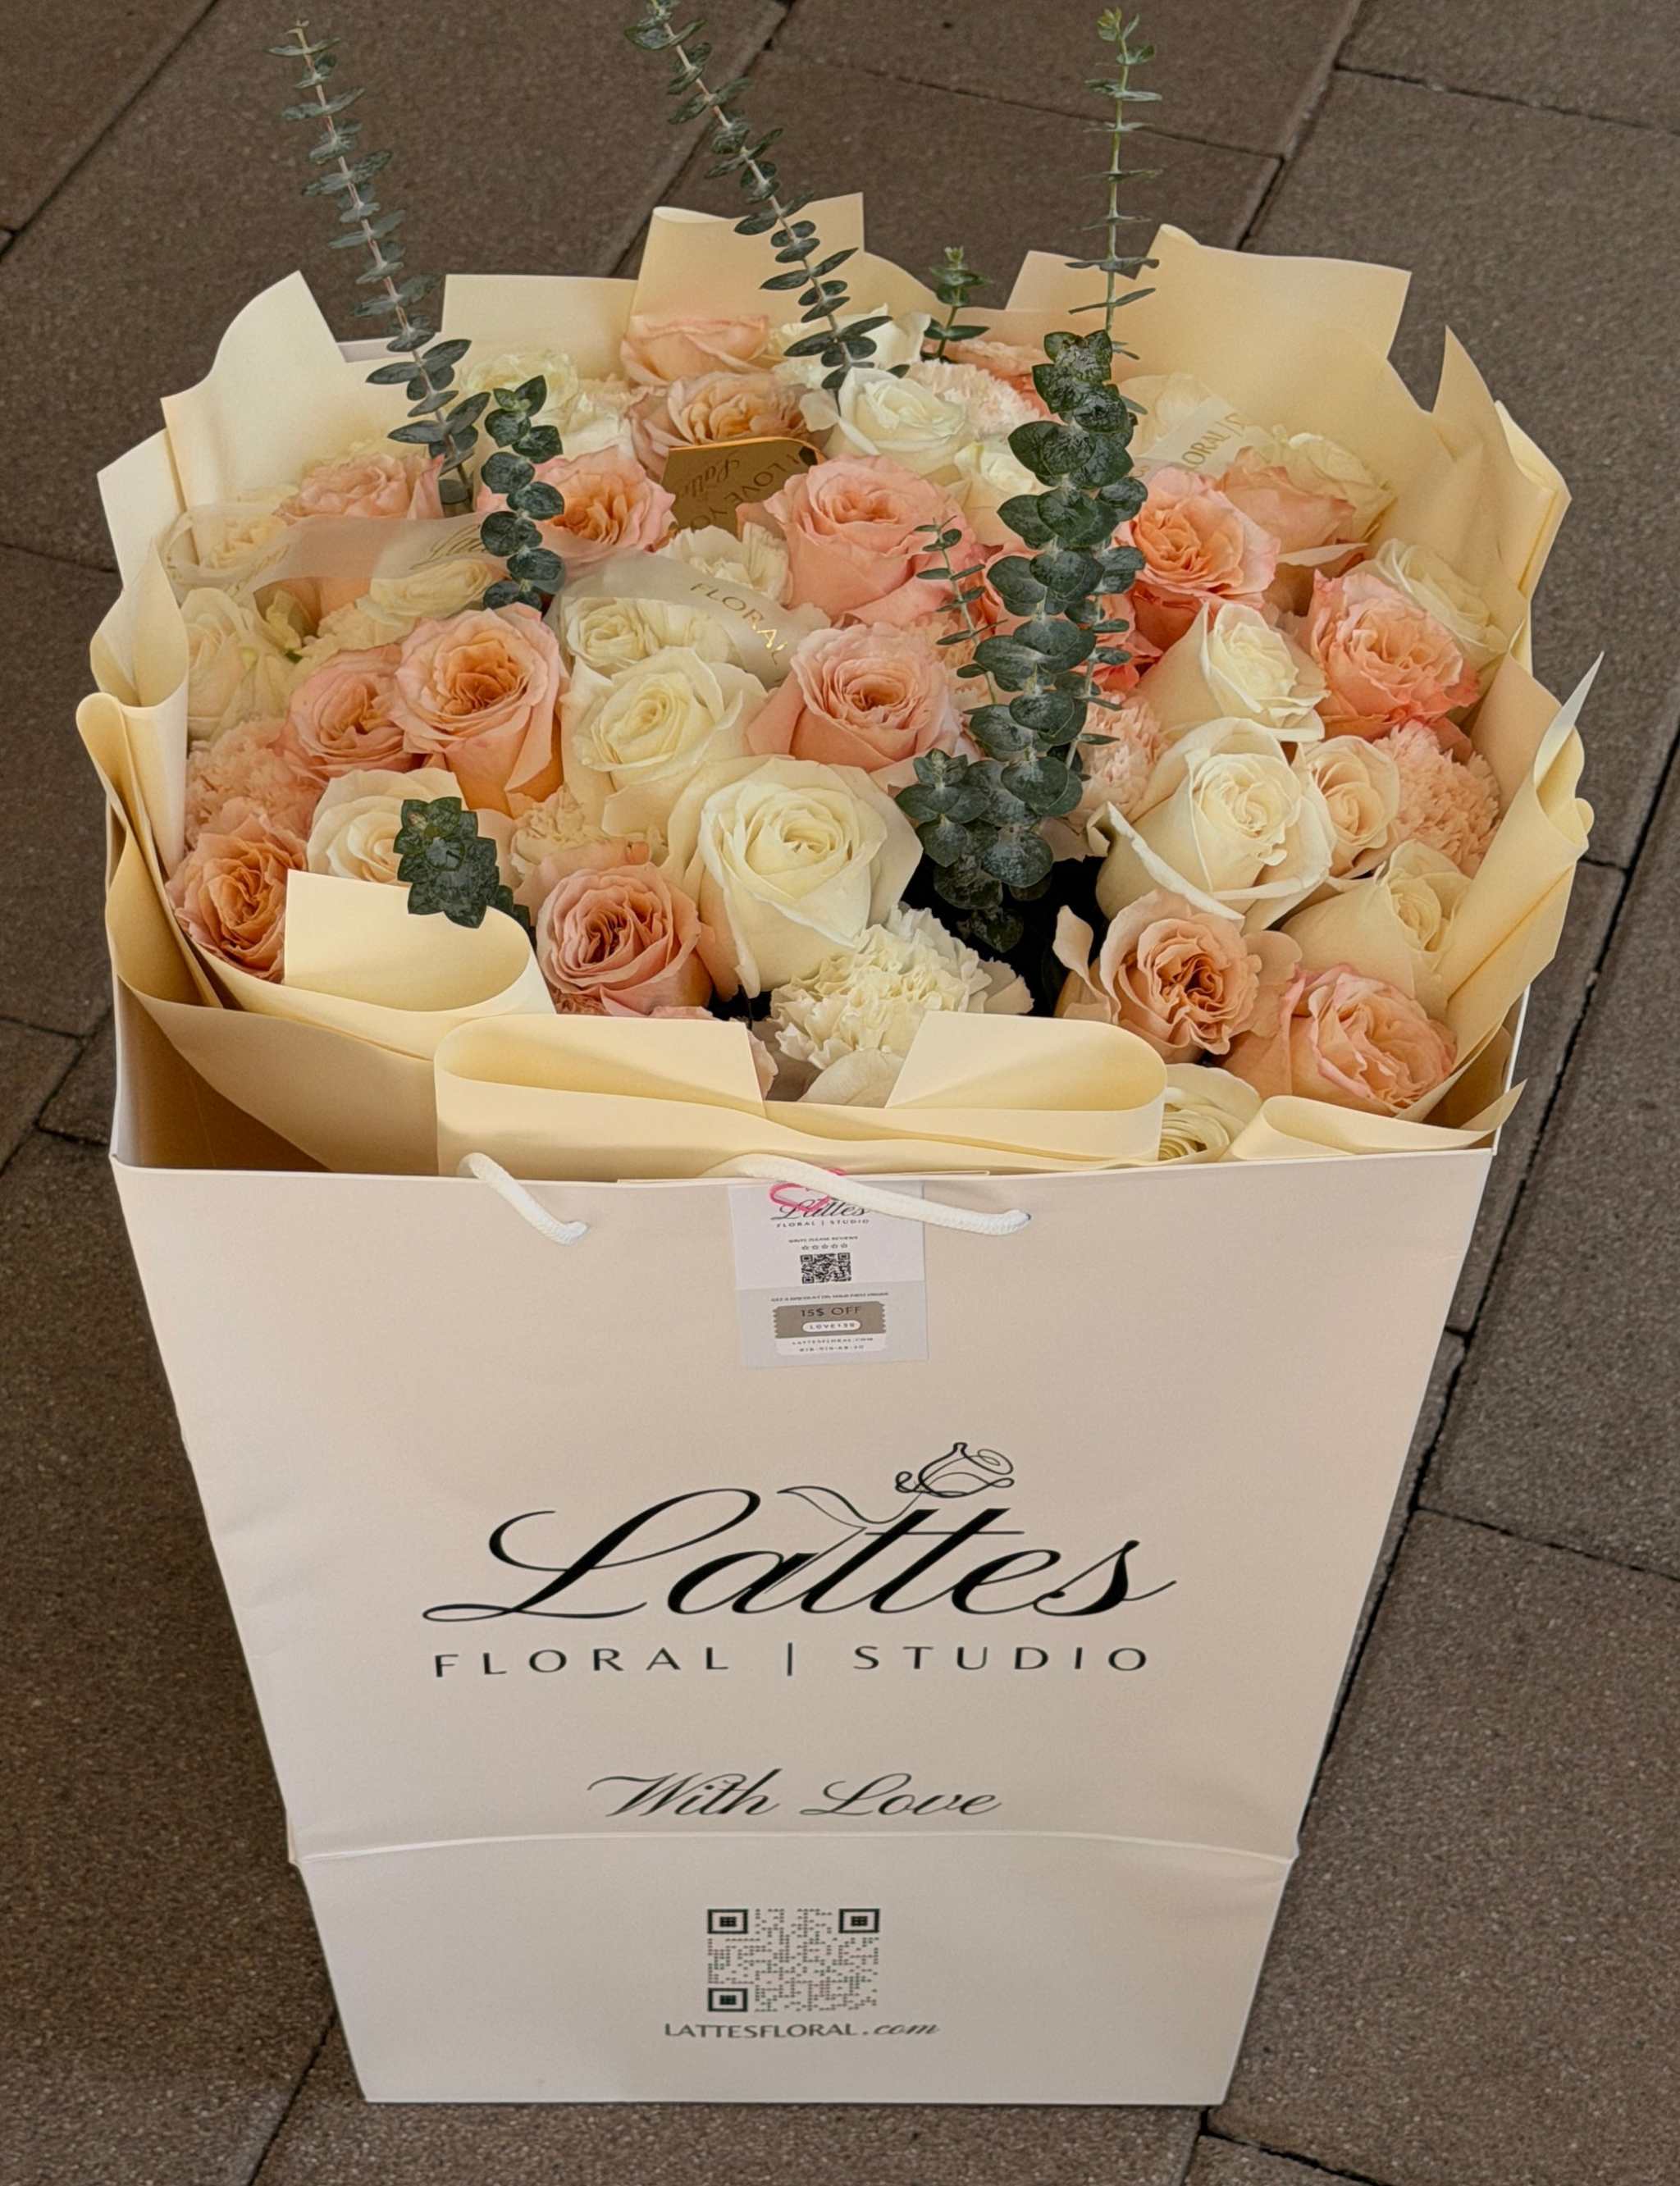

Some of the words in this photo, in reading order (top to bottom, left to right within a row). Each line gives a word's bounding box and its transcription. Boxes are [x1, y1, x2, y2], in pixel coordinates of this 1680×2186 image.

[724, 462, 786, 504] LOVE
[690, 506, 728, 531] YO
[690, 582, 788, 666] FLORAL
[801, 1307, 825, 1317] 15$
[830, 1305, 861, 1316] OFF
[422, 1487, 1177, 1622] Lattes
[434, 1645, 730, 1678] FLORAL
[853, 1645, 1149, 1673] STUDIO
[587, 1768, 783, 1818] With
[799, 1772, 1002, 1817] Love
[664, 2022, 940, 2039] LATTESFLORAL.com
